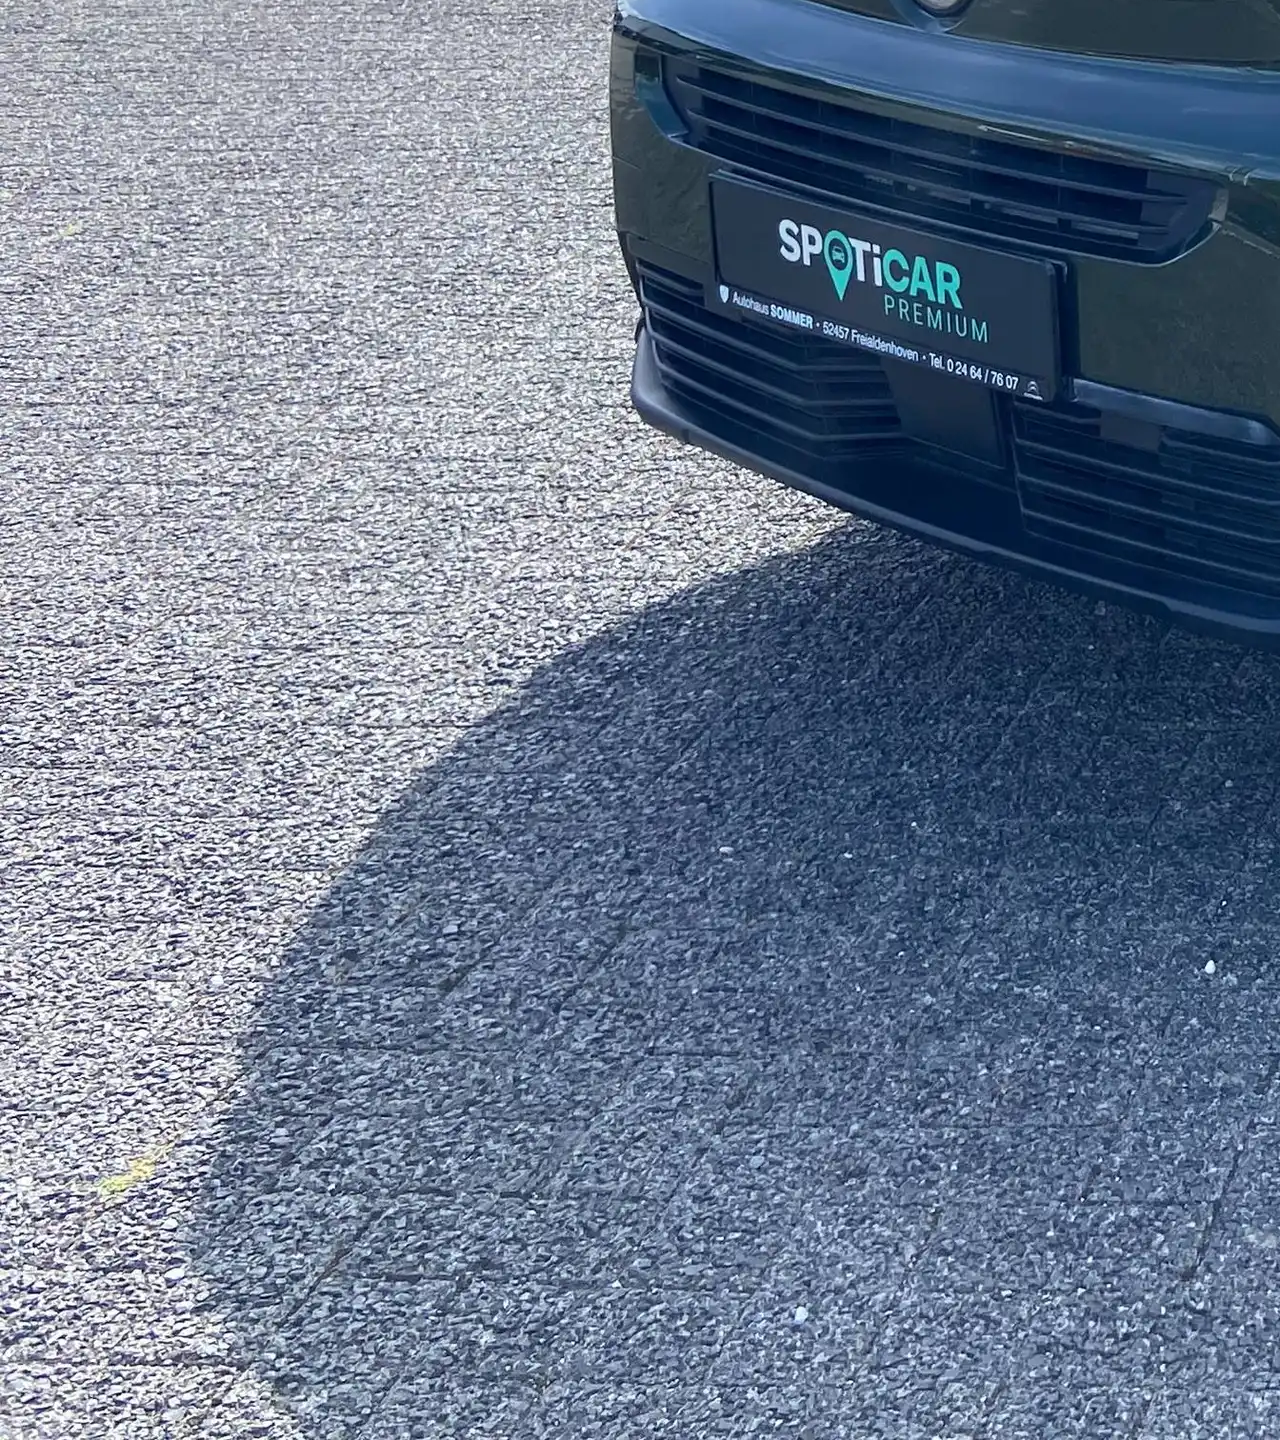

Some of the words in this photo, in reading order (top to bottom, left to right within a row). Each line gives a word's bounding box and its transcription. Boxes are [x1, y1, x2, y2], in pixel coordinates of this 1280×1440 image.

[732, 291, 769, 316] Autohaus
[770, 304, 813, 330] SOMMER
[823, 321, 849, 340] 52457
[851, 329, 919, 361] Freialdenhoven
[929, 352, 945, 369] Tel.
[884, 294, 989, 343] PREMIUM
